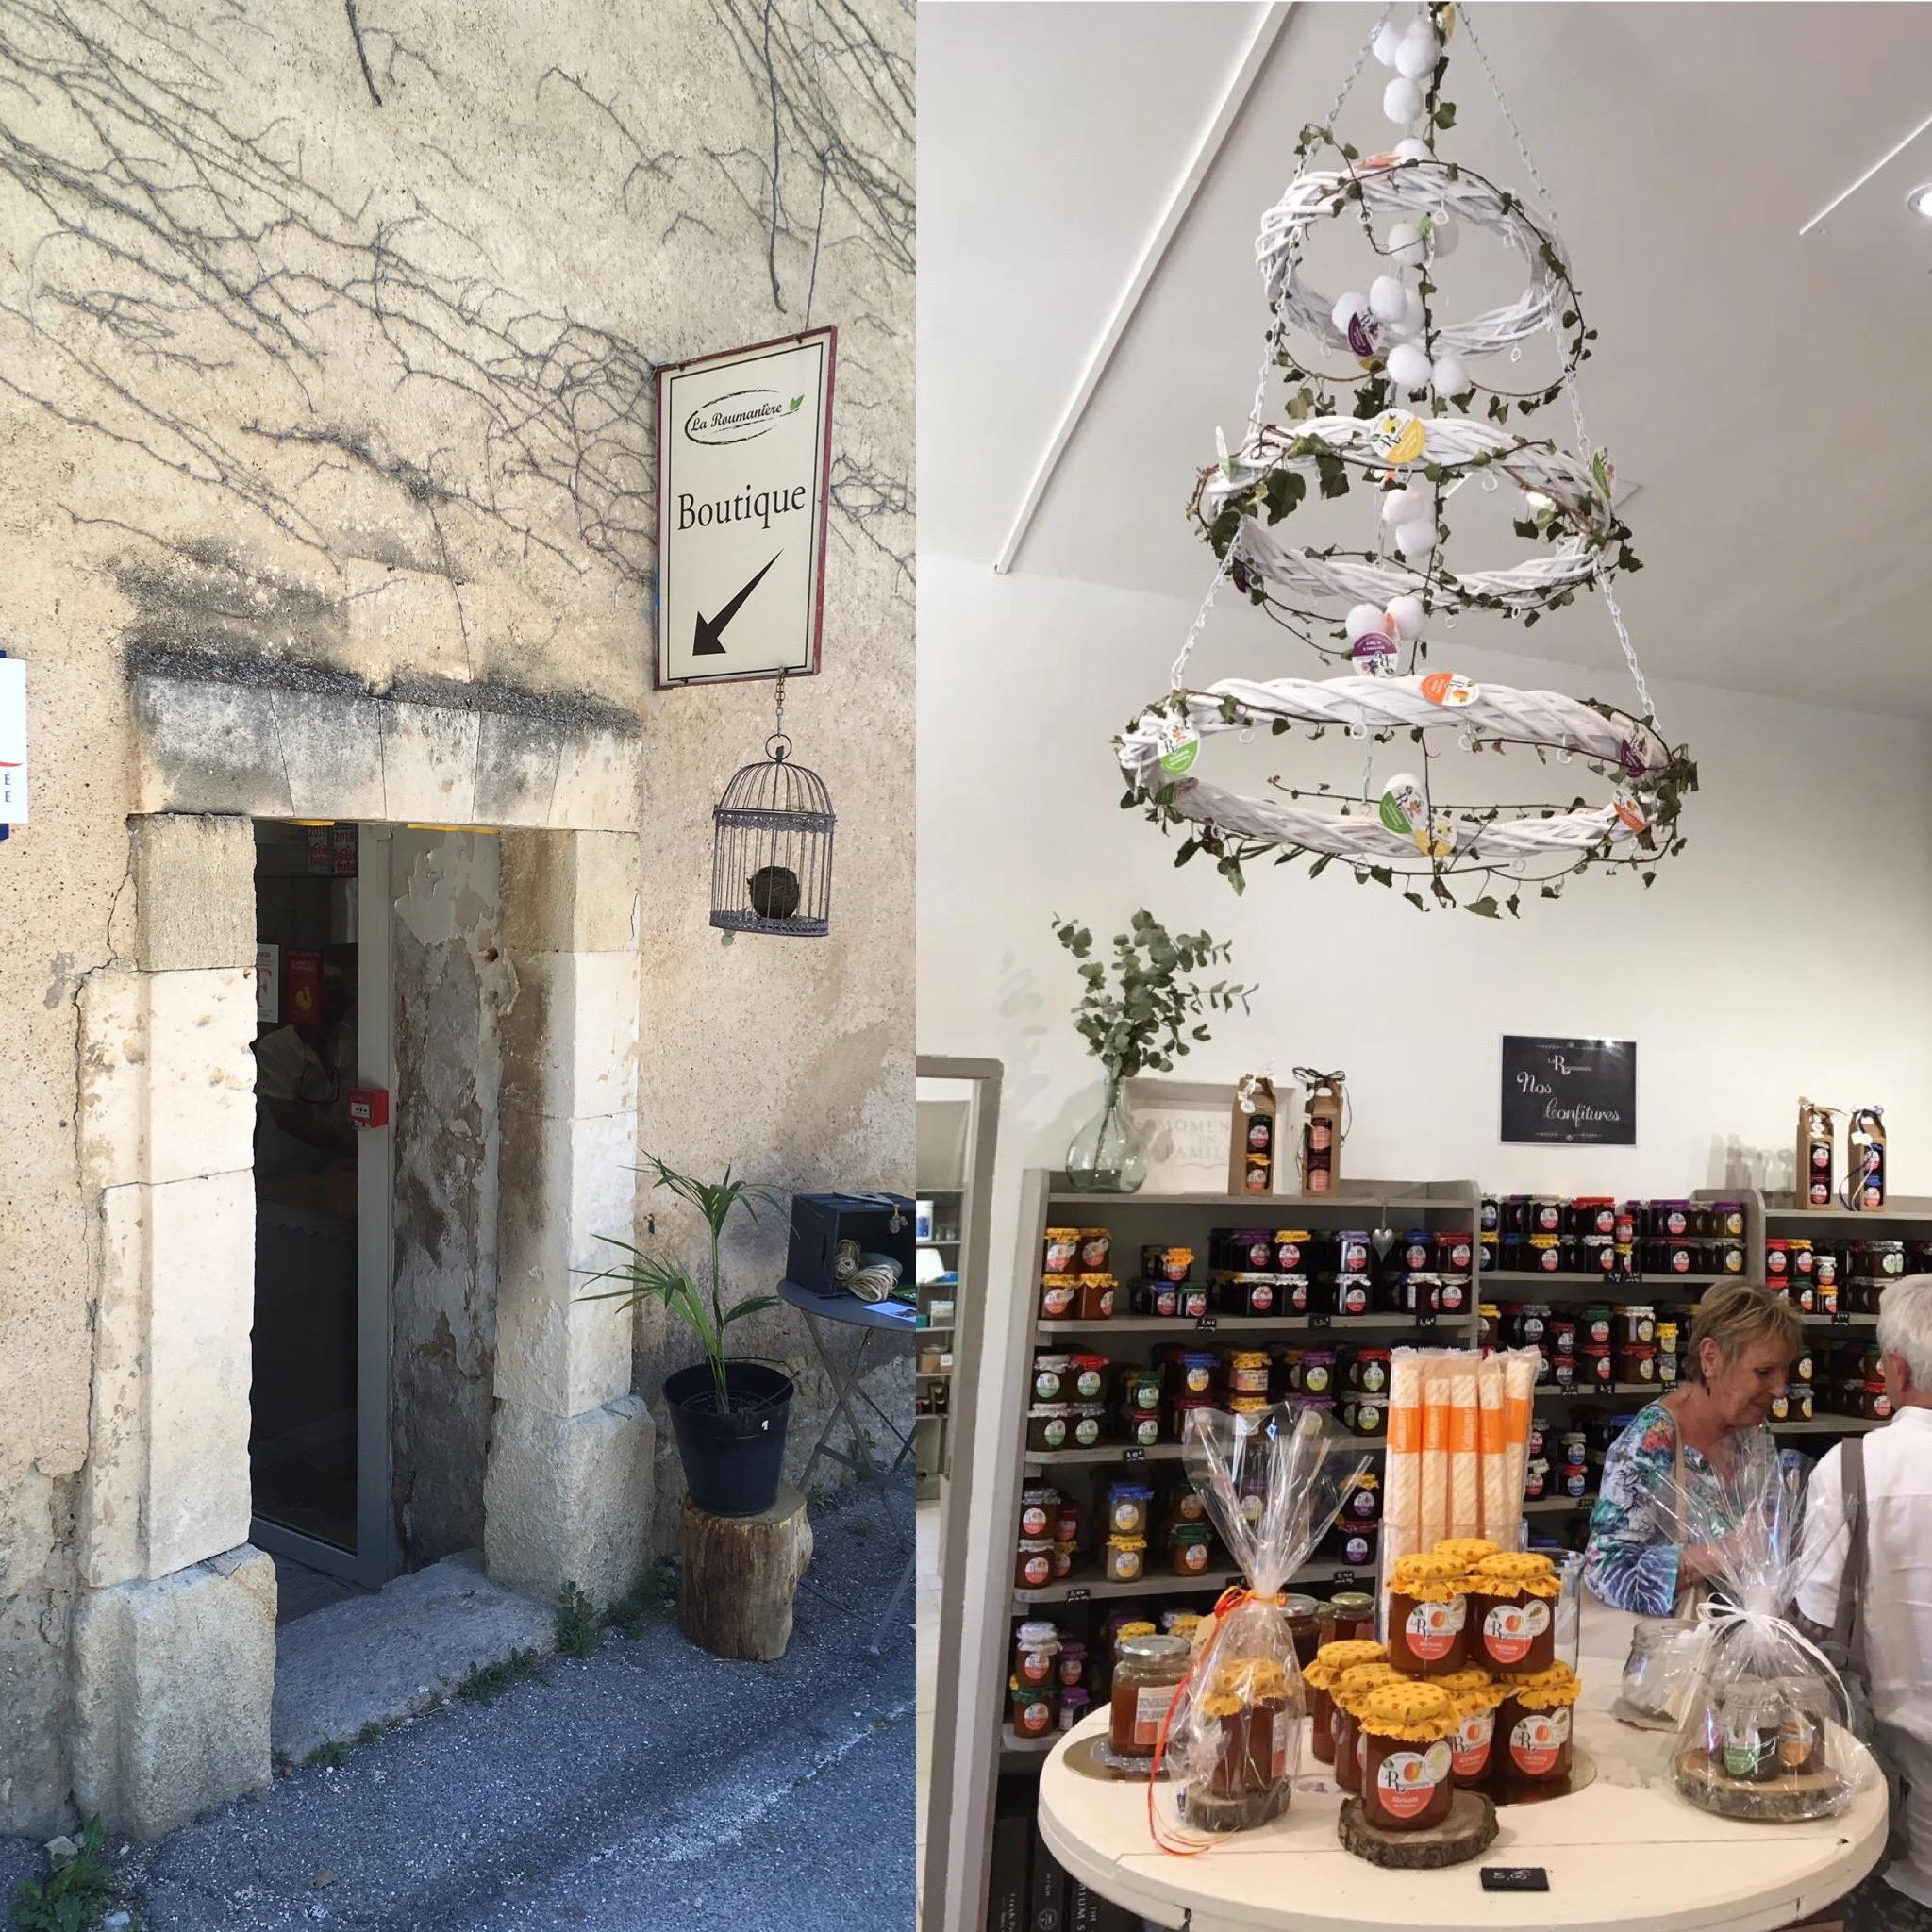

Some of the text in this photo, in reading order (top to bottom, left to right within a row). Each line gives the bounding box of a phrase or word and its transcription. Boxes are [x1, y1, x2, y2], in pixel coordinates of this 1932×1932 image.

[691, 403, 783, 432] La Roumanière
[677, 484, 806, 531] Boutique
[334, 831, 355, 842] 2018
[1517, 1071, 1552, 1093] Nos
[1158, 1118, 1230, 1132] MOMEN
[1544, 1097, 1621, 1128] Confitures
